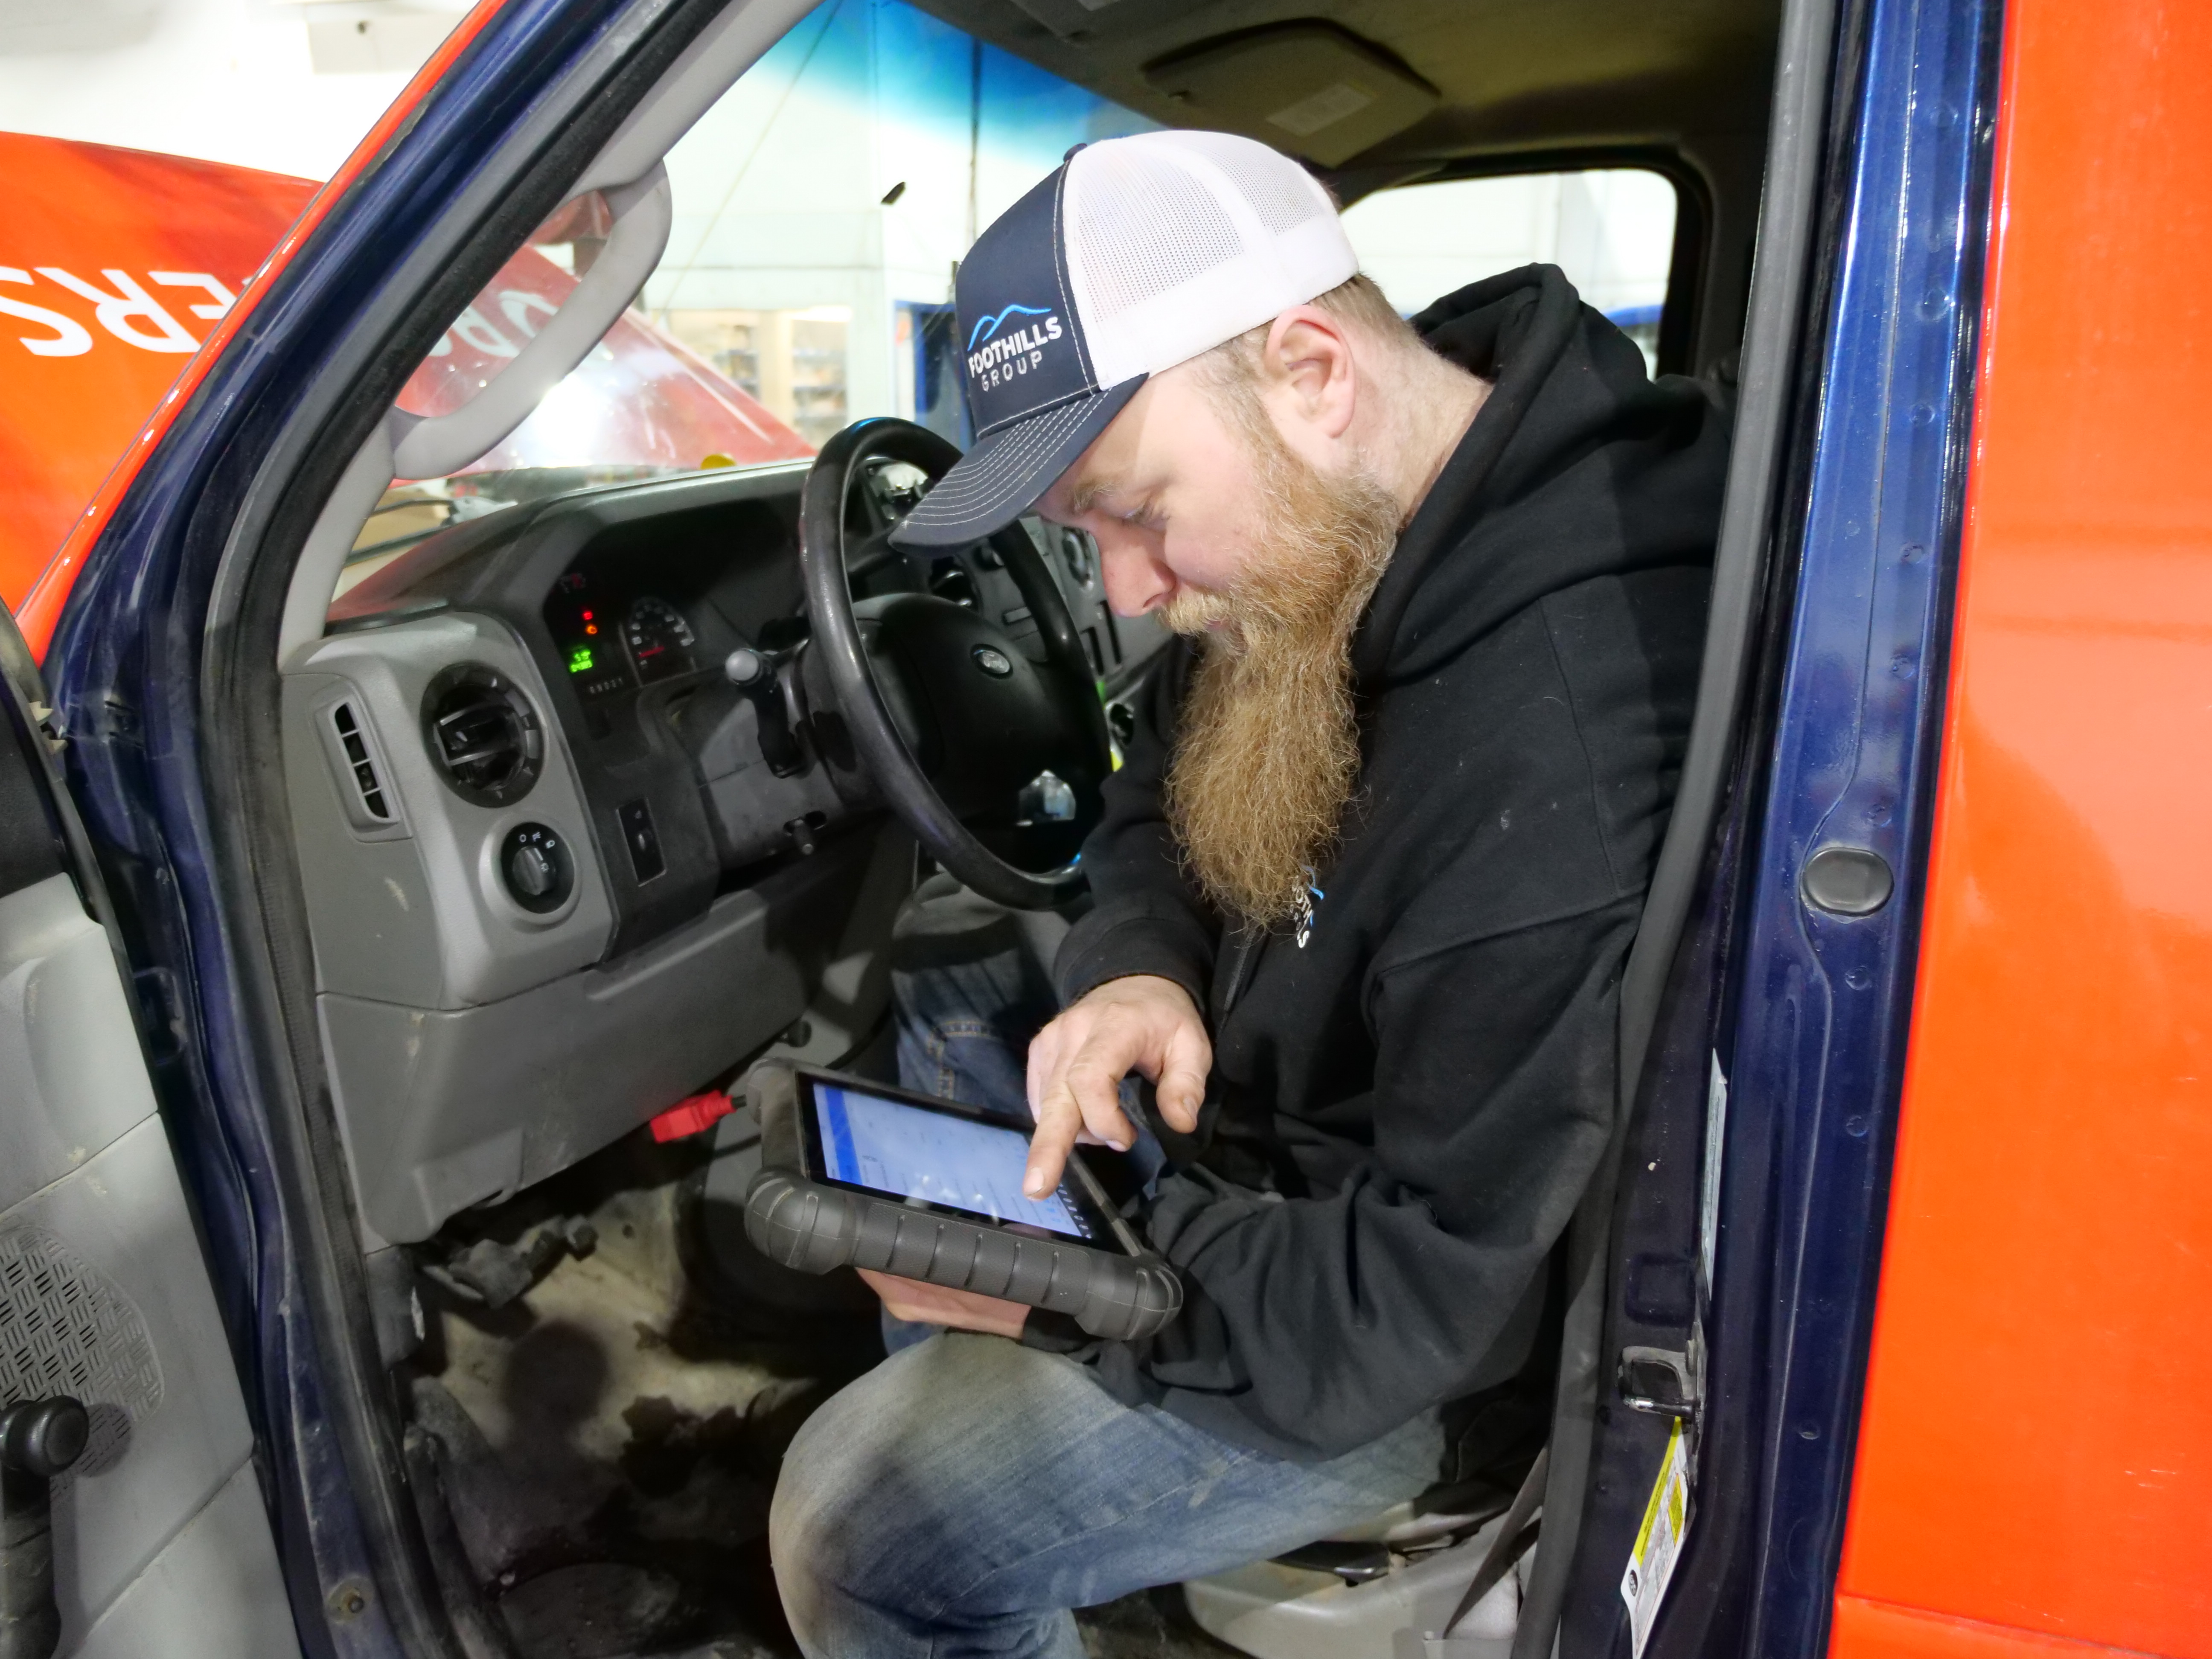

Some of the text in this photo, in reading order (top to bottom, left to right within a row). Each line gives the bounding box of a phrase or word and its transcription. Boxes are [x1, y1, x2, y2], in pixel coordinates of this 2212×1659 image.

[0, 266, 253, 357] ERS
[968, 316, 1062, 378] FOOTHILLS
[982, 350, 1042, 392] GROUP
